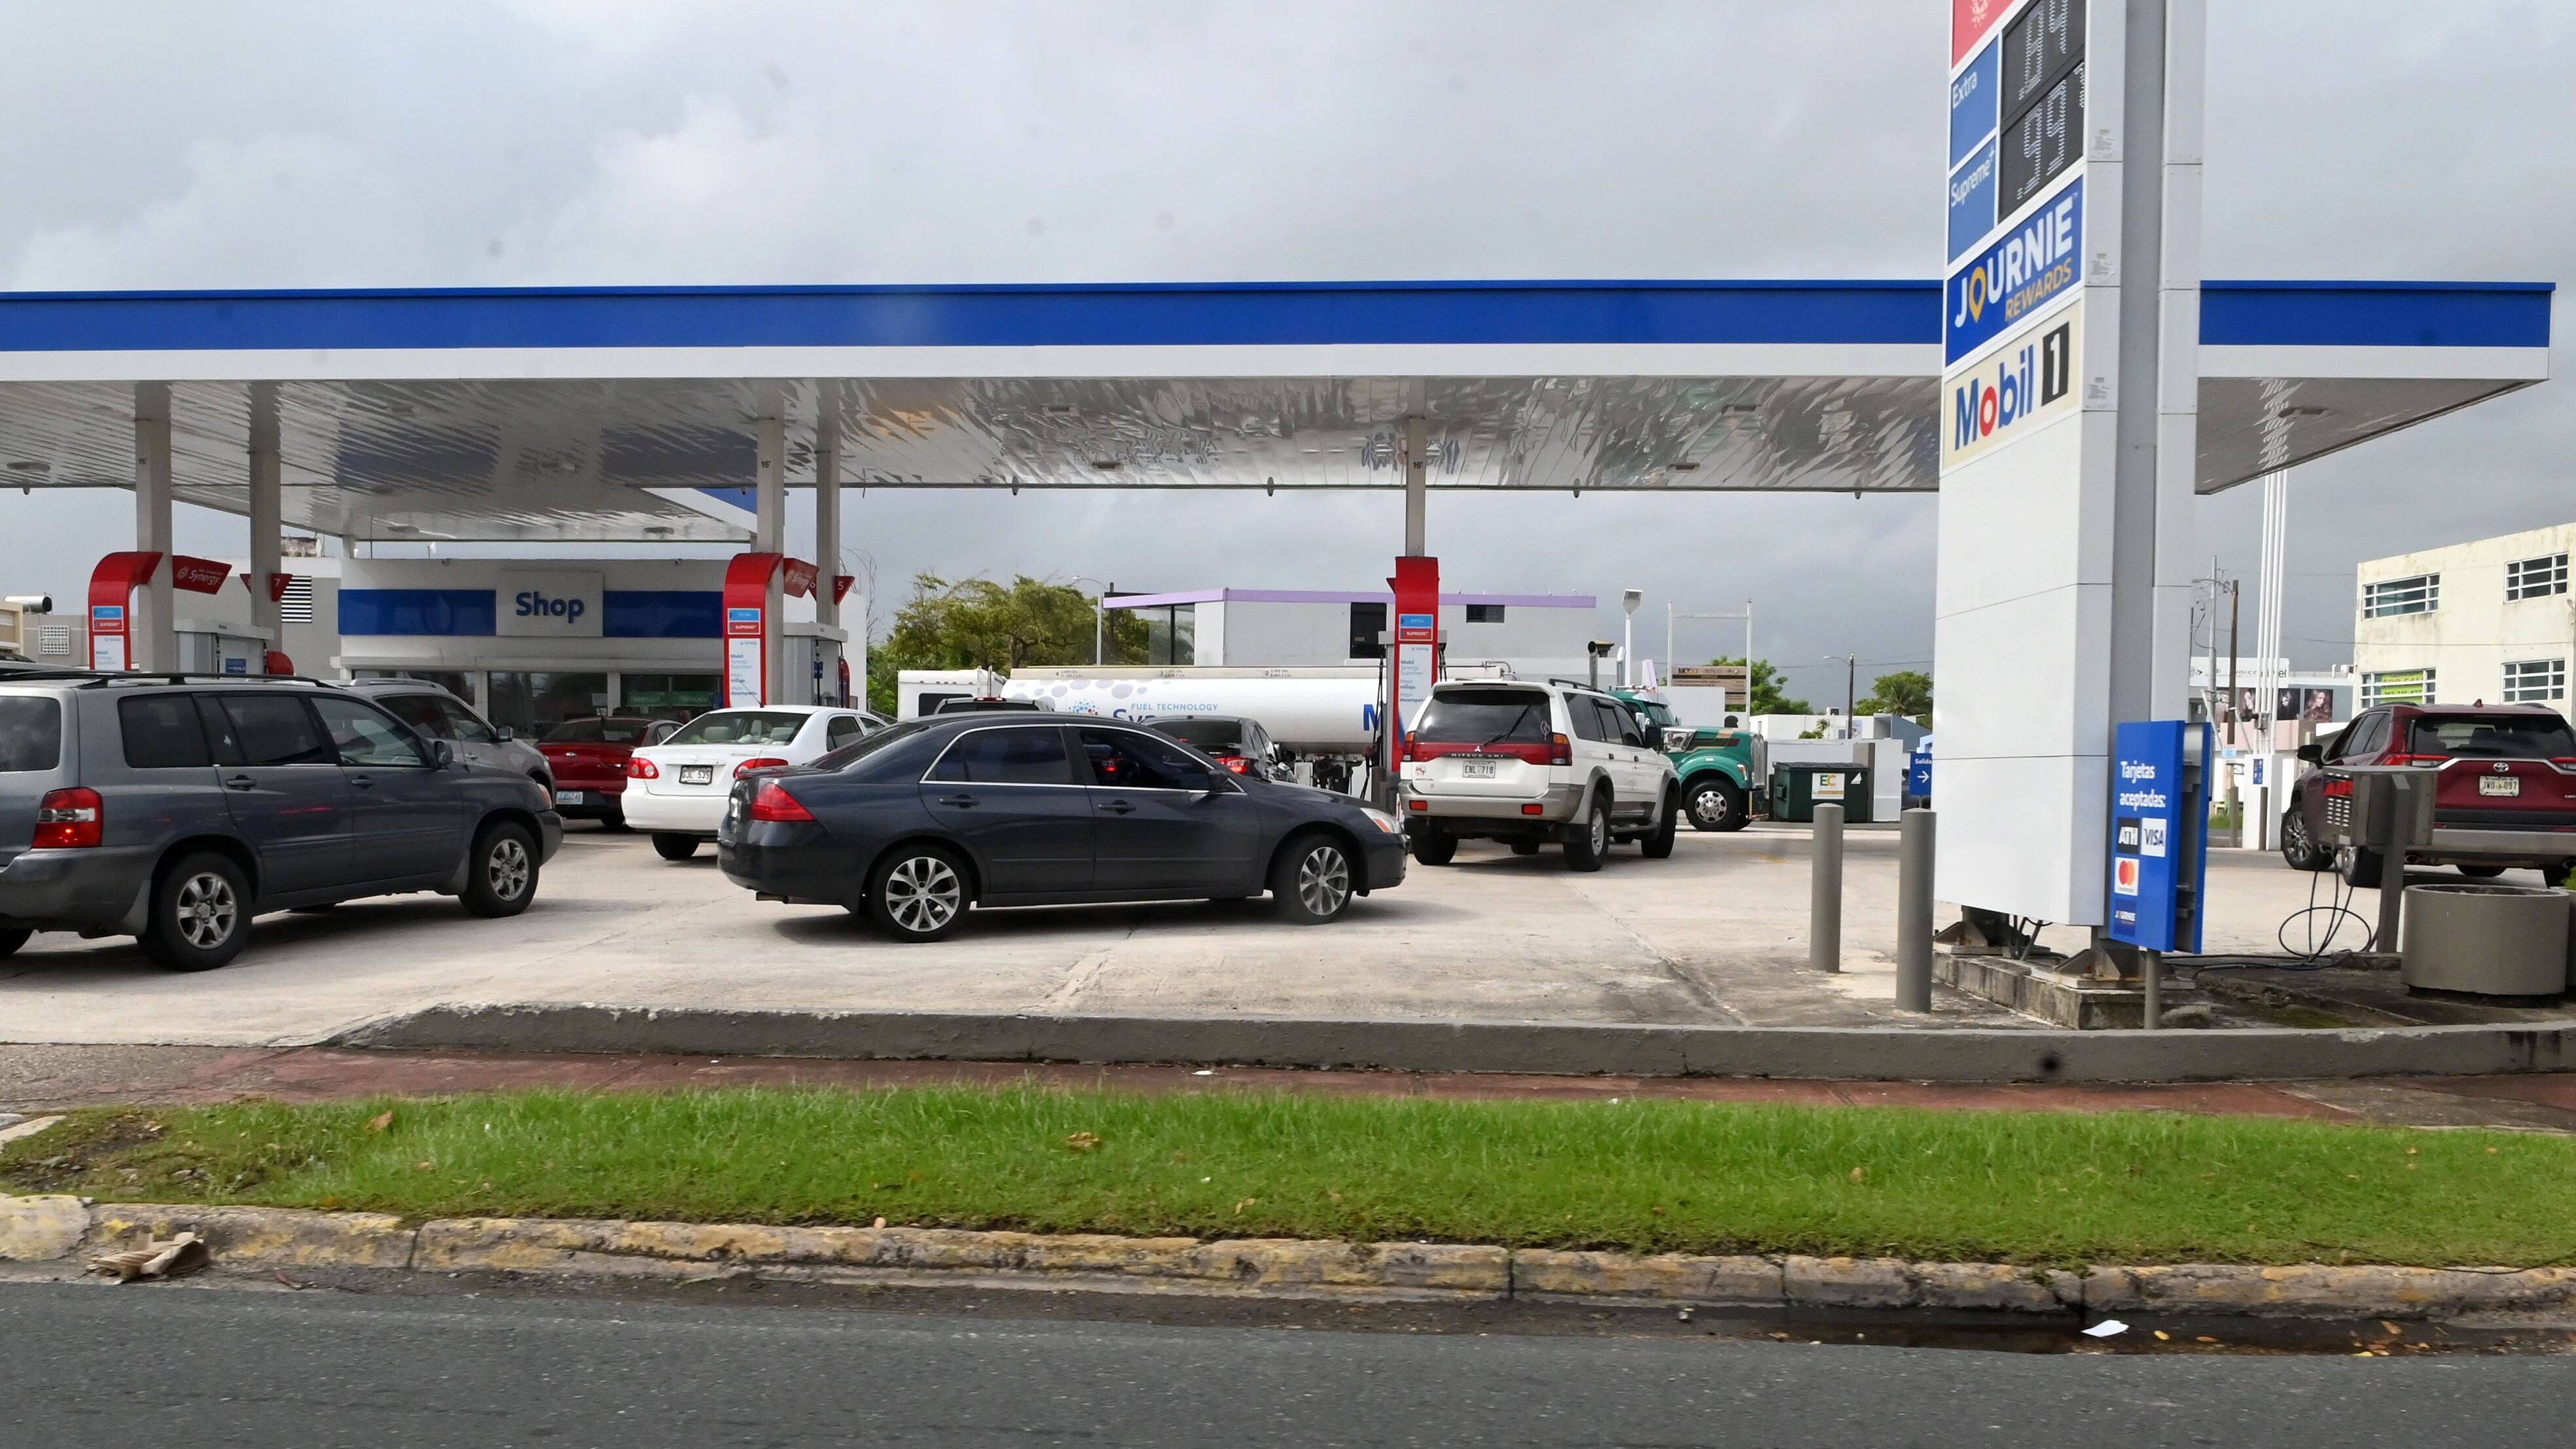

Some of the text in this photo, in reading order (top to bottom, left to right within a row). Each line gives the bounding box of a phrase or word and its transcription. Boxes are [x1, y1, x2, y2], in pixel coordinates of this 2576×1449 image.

[1953, 71, 1977, 108] Extra
[2005, 257, 2073, 321] REWARDS
[1955, 344, 2034, 451] Mobil
[188, 569, 221, 586] Synergy
[838, 581, 844, 590] 5
[516, 591, 584, 624] Shop
[1820, 775, 1836, 786] EC
[2120, 760, 2155, 783] Tarjetas
[2144, 828, 2164, 846] VISA
